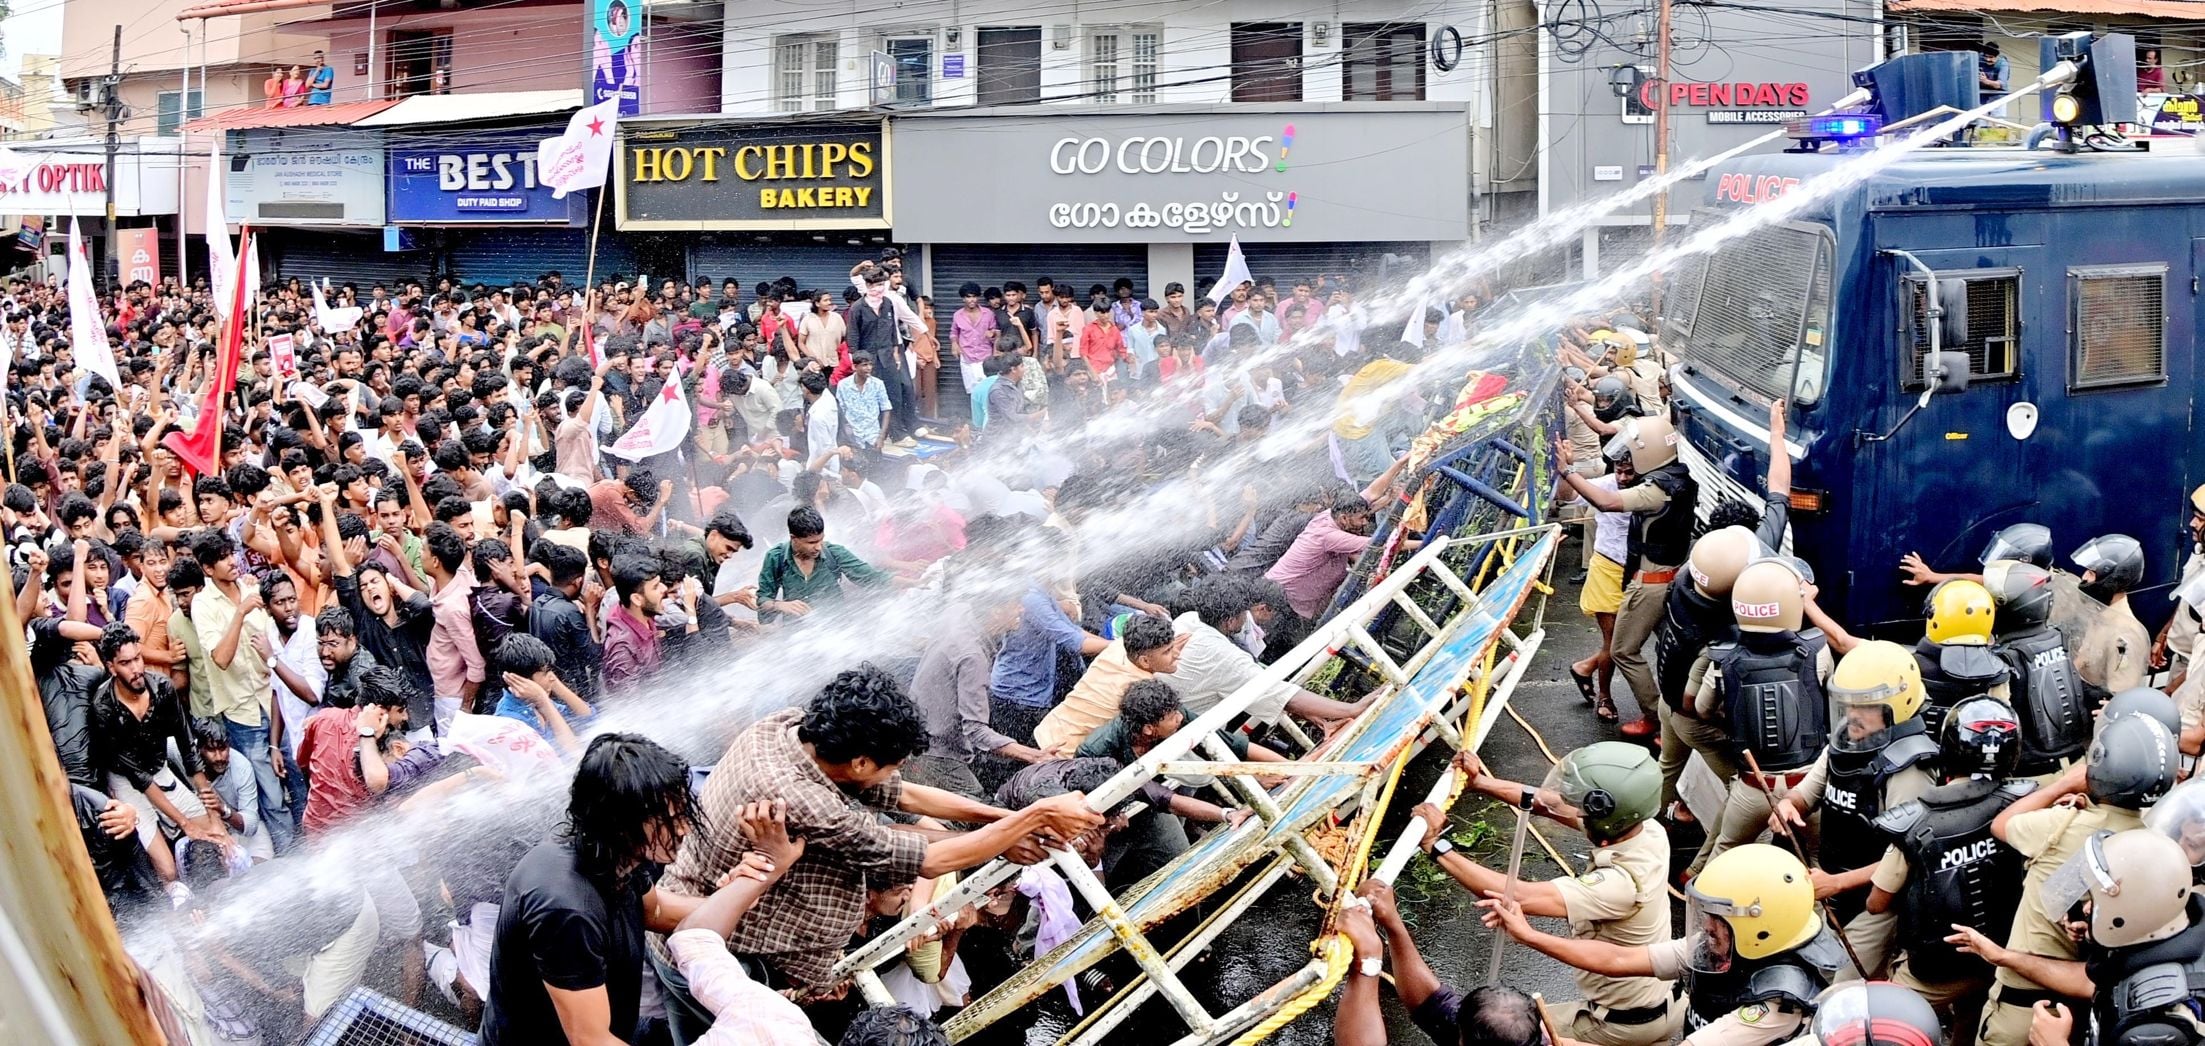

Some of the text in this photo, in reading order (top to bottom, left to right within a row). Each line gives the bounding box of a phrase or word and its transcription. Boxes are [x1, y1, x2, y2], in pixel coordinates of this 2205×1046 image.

[1736, 82, 1810, 107] DAYS
[1709, 111, 1744, 122] MOBILE
[633, 142, 874, 182] HOT CHIPS
[1049, 136, 1111, 174] GO
[38, 163, 107, 193] OPTIK
[405, 157, 431, 170] THE
[438, 152, 537, 191] BEST
[457, 198, 522, 207] DUTY PAID SHOP
[760, 186, 873, 209] BAKERY
[1049, 201, 1120, 229] ഗോ
[1734, 602, 1778, 617] POLICE
[2034, 646, 2067, 669] POLICE
[1941, 837, 1997, 869] POLICE
